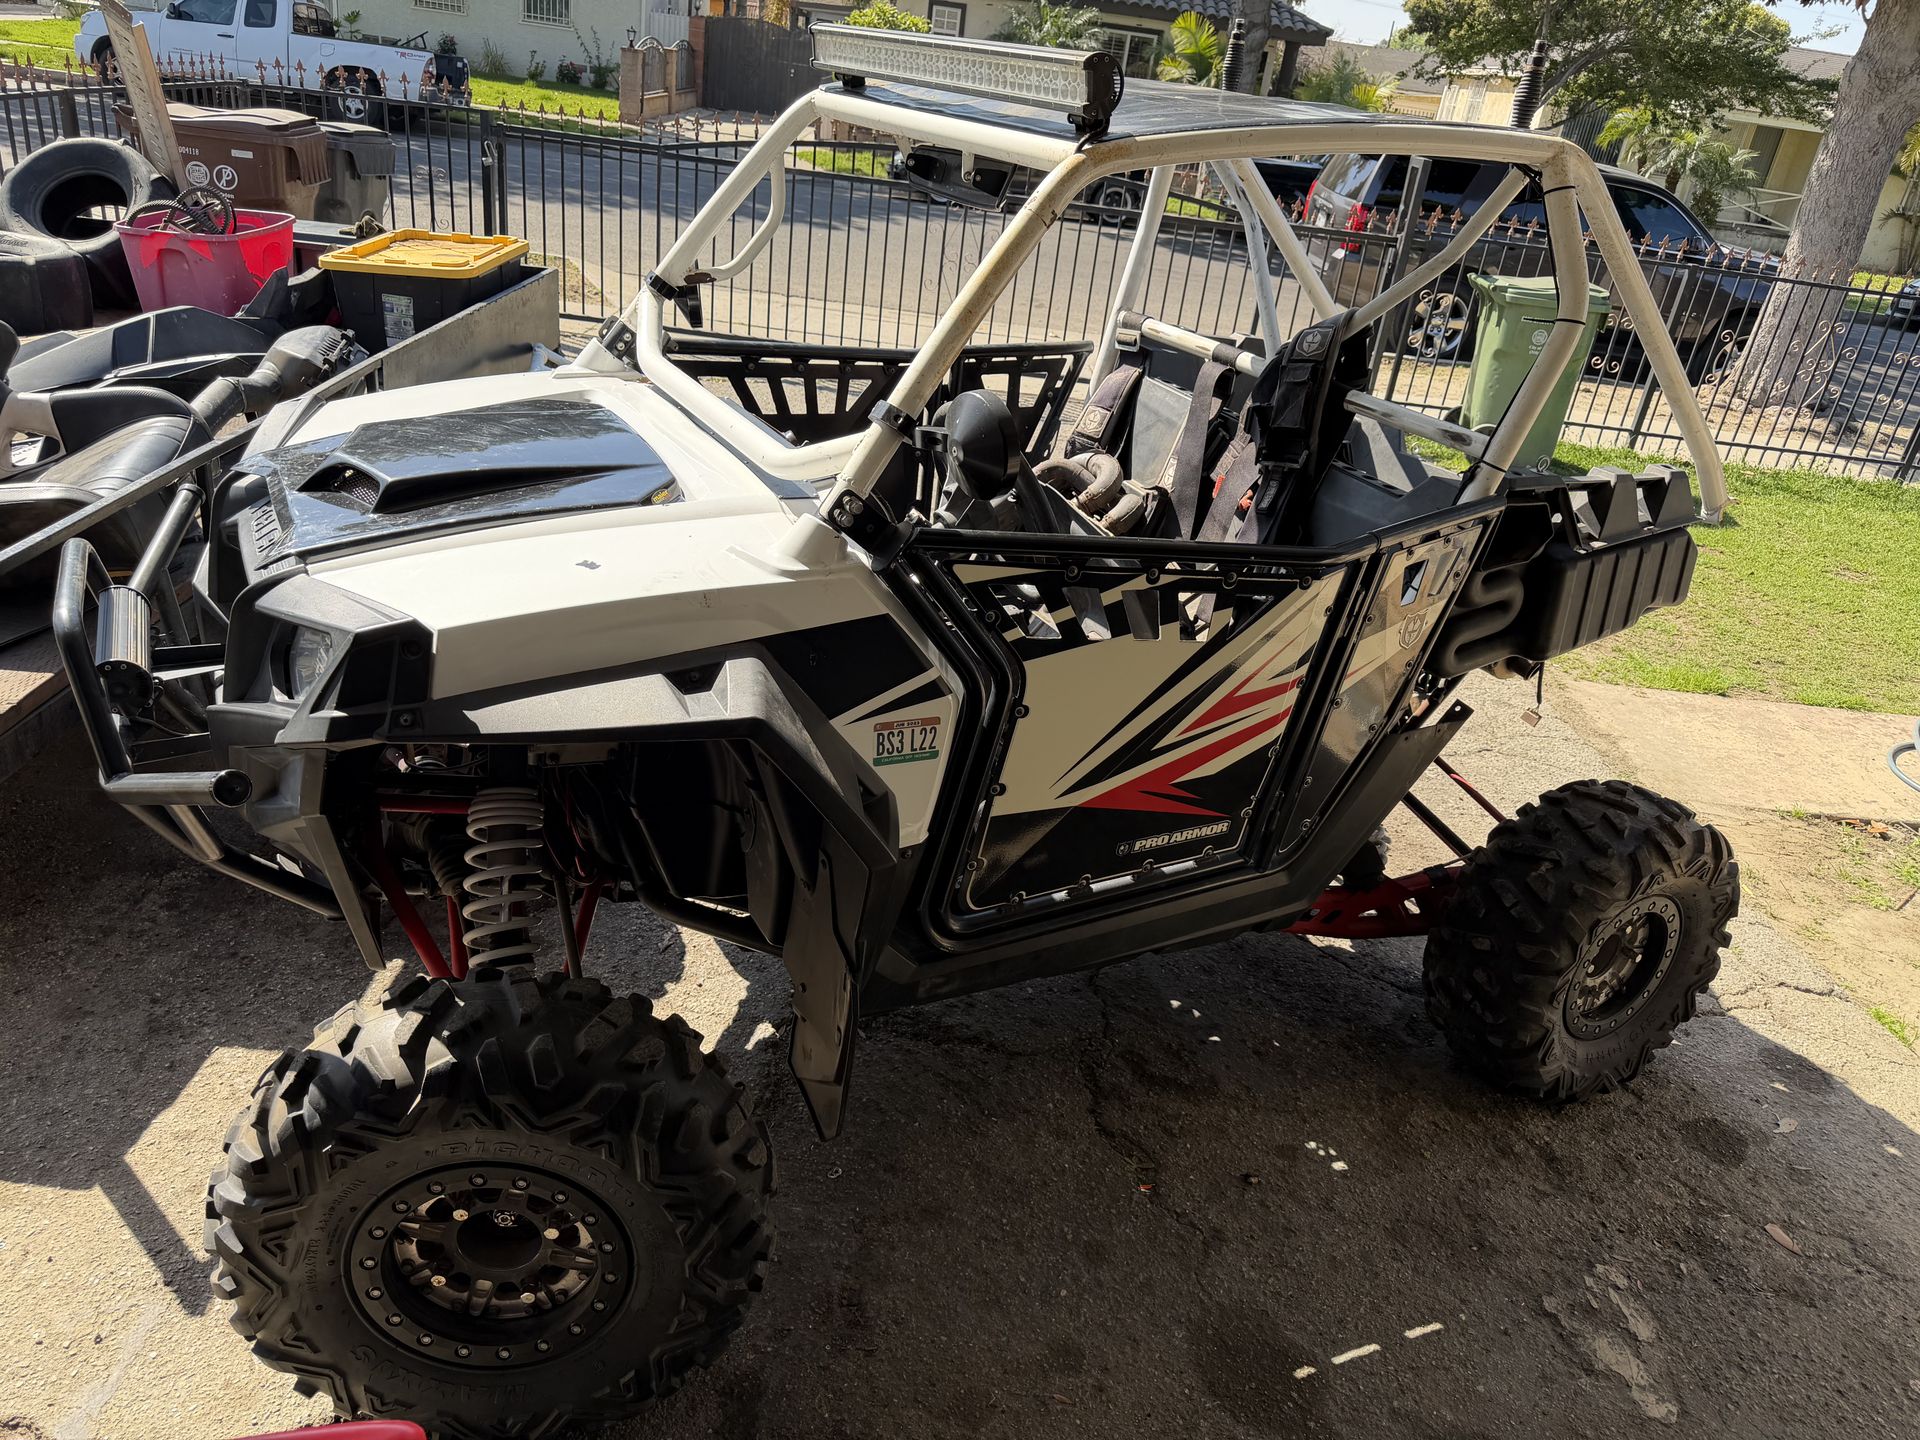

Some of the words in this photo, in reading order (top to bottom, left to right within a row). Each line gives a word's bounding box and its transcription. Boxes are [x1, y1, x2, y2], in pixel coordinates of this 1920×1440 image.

[876, 730, 905, 756] BS3
[910, 726, 937, 752] L22
[1133, 834, 1170, 851] PRO
[1169, 822, 1229, 843] ARMOR
